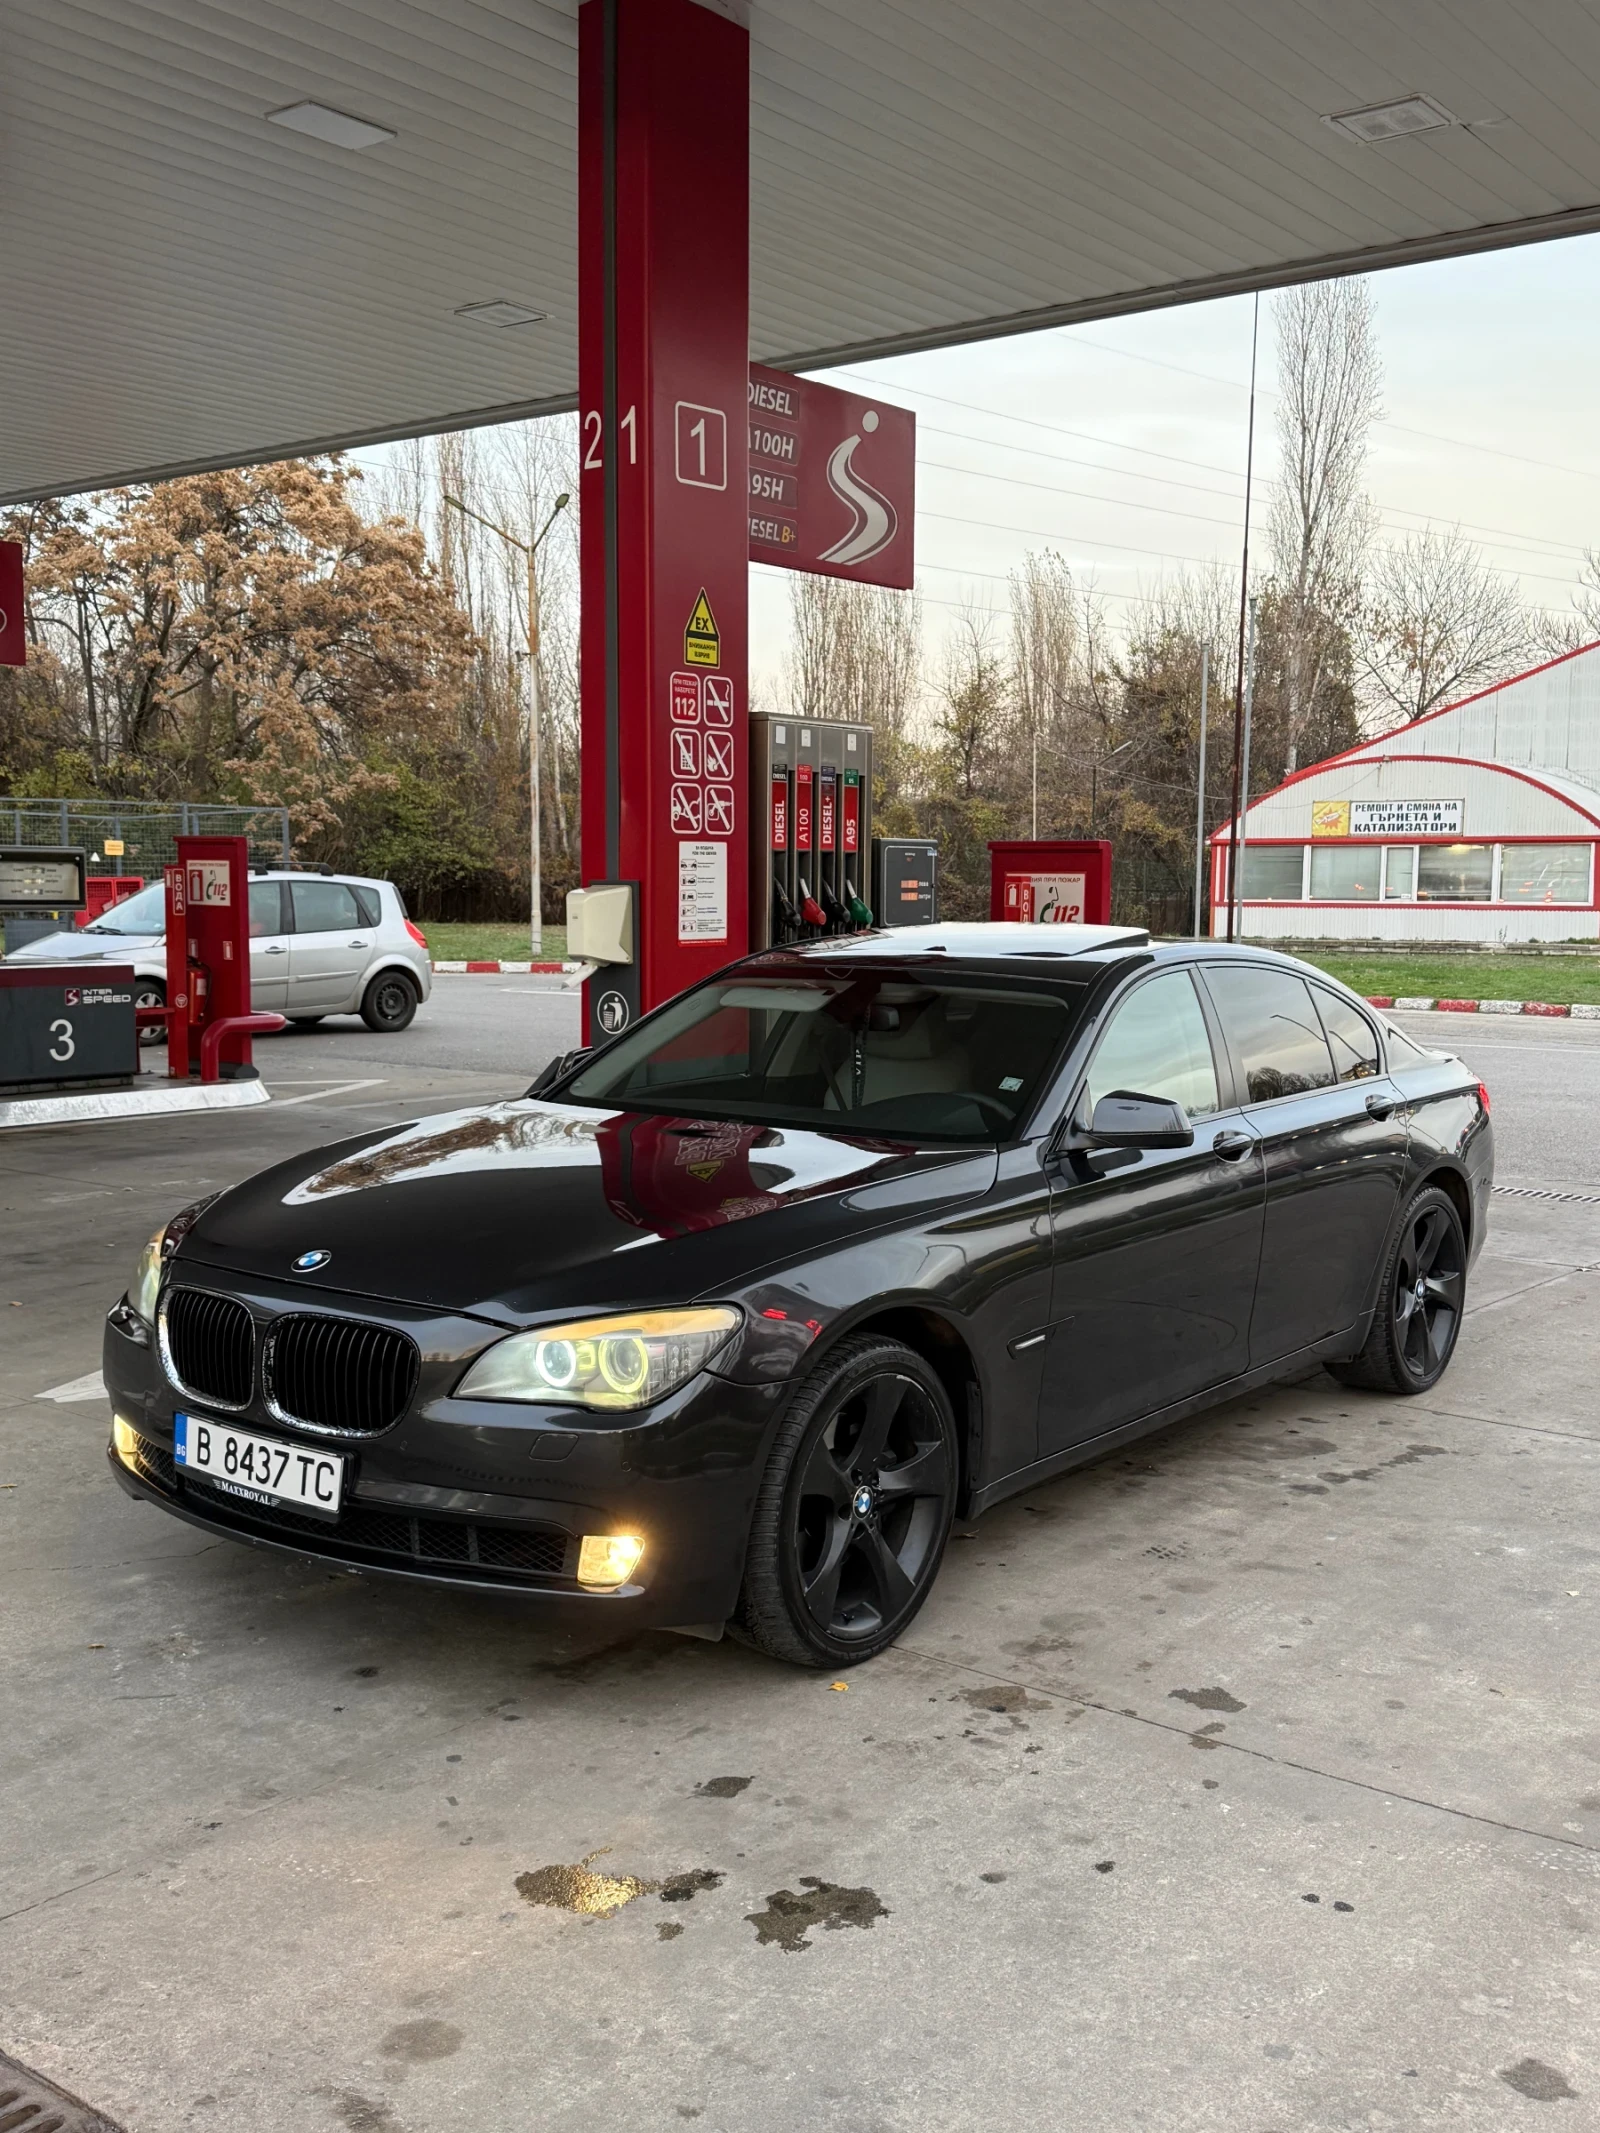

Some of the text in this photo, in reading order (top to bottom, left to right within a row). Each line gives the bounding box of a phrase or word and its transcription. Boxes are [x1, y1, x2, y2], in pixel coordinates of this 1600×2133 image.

[584, 410, 603, 470] 2
[620, 405, 637, 465] 1
[690, 418, 706, 477] 1
[749, 427, 794, 459] 100H
[749, 474, 784, 501] 95H
[696, 617, 709, 631] EX
[675, 697, 696, 716] 112
[1355, 803, 1394, 812] РЕМОНТ
[1407, 803, 1441, 811] СМЯНА
[1445, 802, 1458, 810] НА
[1370, 812, 1442, 822] ГЪРНЕТА И
[774, 800, 785, 843] DIESEL
[799, 808, 809, 843] A100
[846, 818, 856, 845] A95
[1354, 823, 1457, 832] КАТАЛИЗАТОРИ
[175, 873, 184, 911] ВОДА
[213, 883, 228, 897] 112
[1053, 905, 1080, 922] 112
[82, 995, 131, 1004] SPEED
[49, 1018, 76, 1061] 3
[176, 1443, 186, 1457] BG
[197, 1425, 335, 1502] B 8437 TC
[221, 1480, 271, 1505] MAXXROYAL
